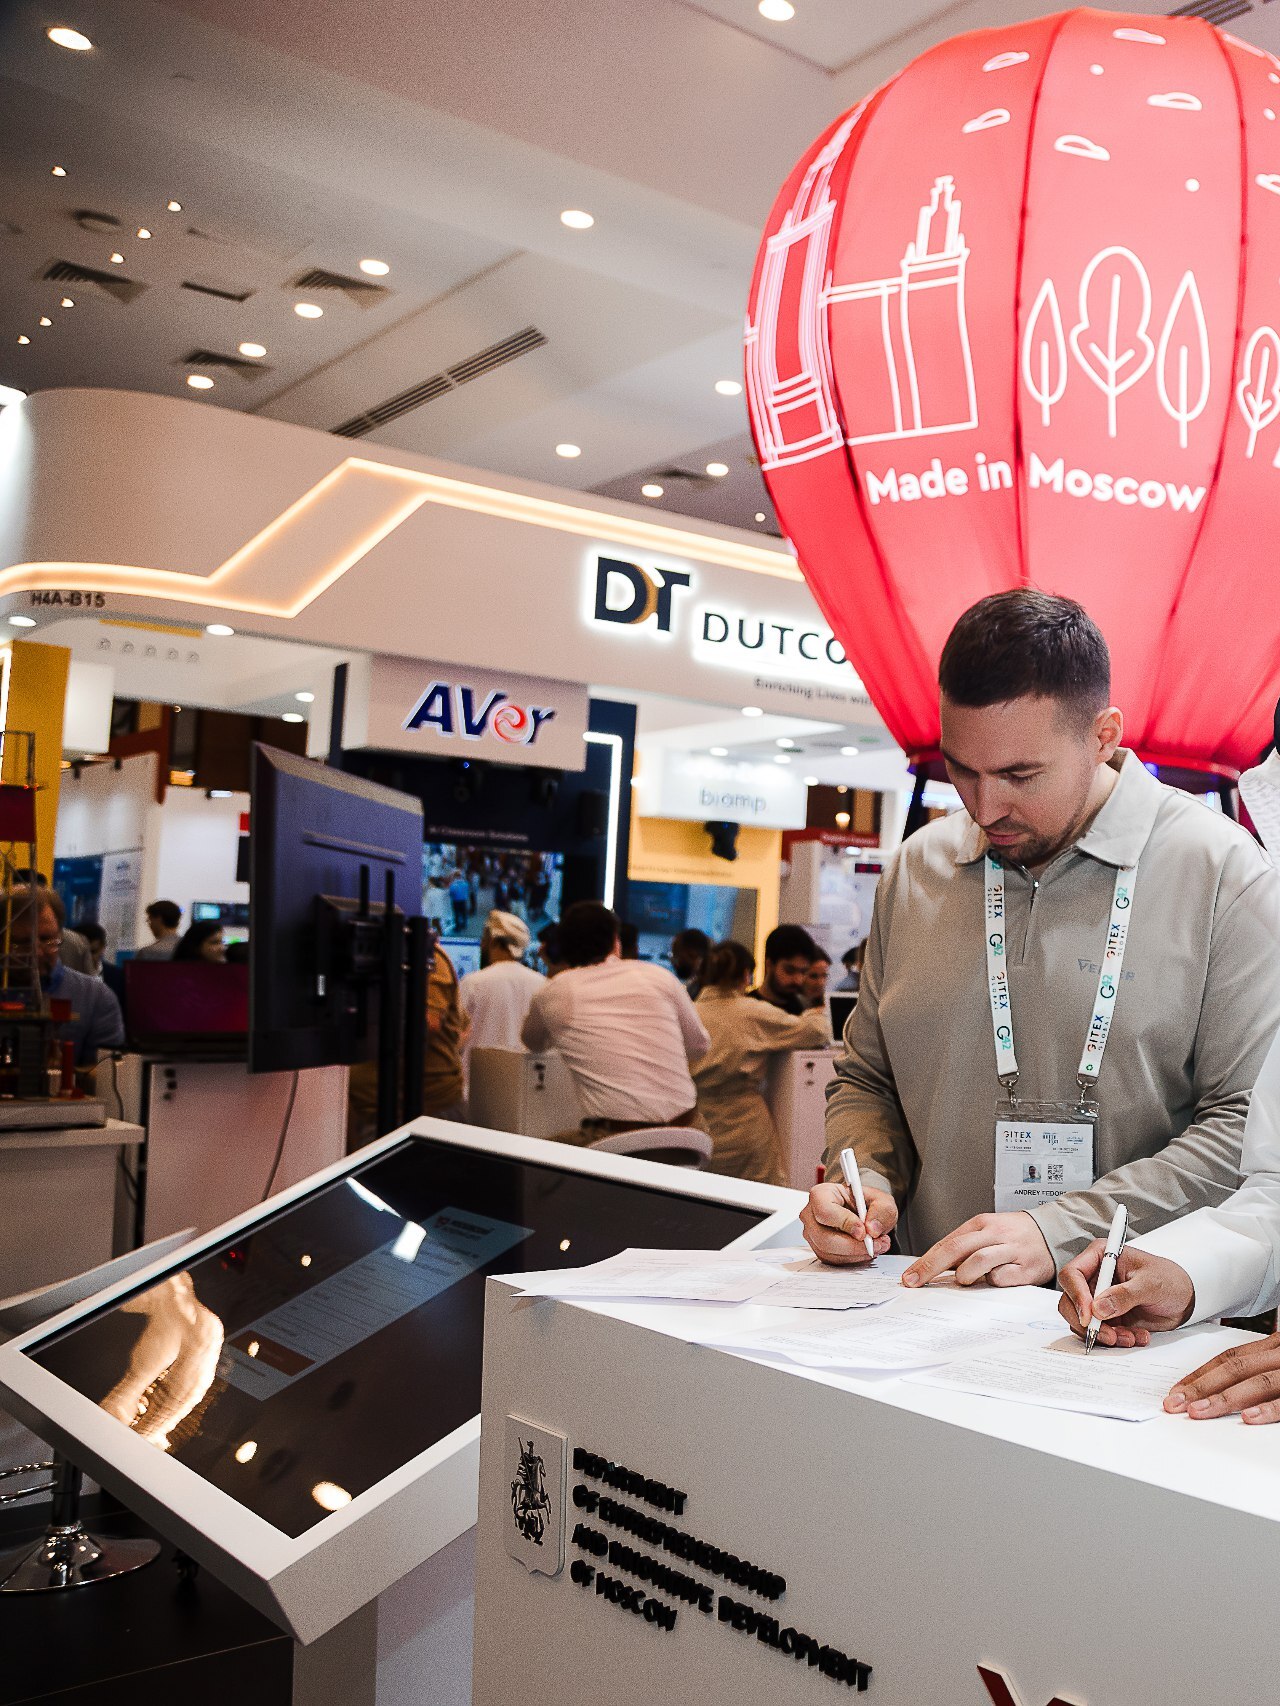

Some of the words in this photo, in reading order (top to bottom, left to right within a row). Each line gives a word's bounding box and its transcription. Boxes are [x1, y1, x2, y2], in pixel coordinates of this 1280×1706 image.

[865, 457, 969, 506] Made
[974, 451, 1014, 492] in
[1028, 451, 1206, 513] Moscow
[594, 556, 691, 632] DT
[702, 612, 848, 665] DUTCO
[993, 884, 1003, 918] GITEX
[1115, 886, 1130, 910] G42
[989, 933, 1004, 957] G42
[1106, 923, 1121, 960] GITEX
[996, 971, 1008, 1010] GITEX
[1100, 974, 1115, 999] G42
[996, 1025, 1012, 1051] G42
[1087, 1014, 1105, 1052] GITEX
[1003, 1130, 1032, 1139] GITEX
[570, 1558, 597, 1588] OF
[595, 1571, 679, 1632] MOSCOW
[717, 1595, 873, 1692] DEVELOPMENT
